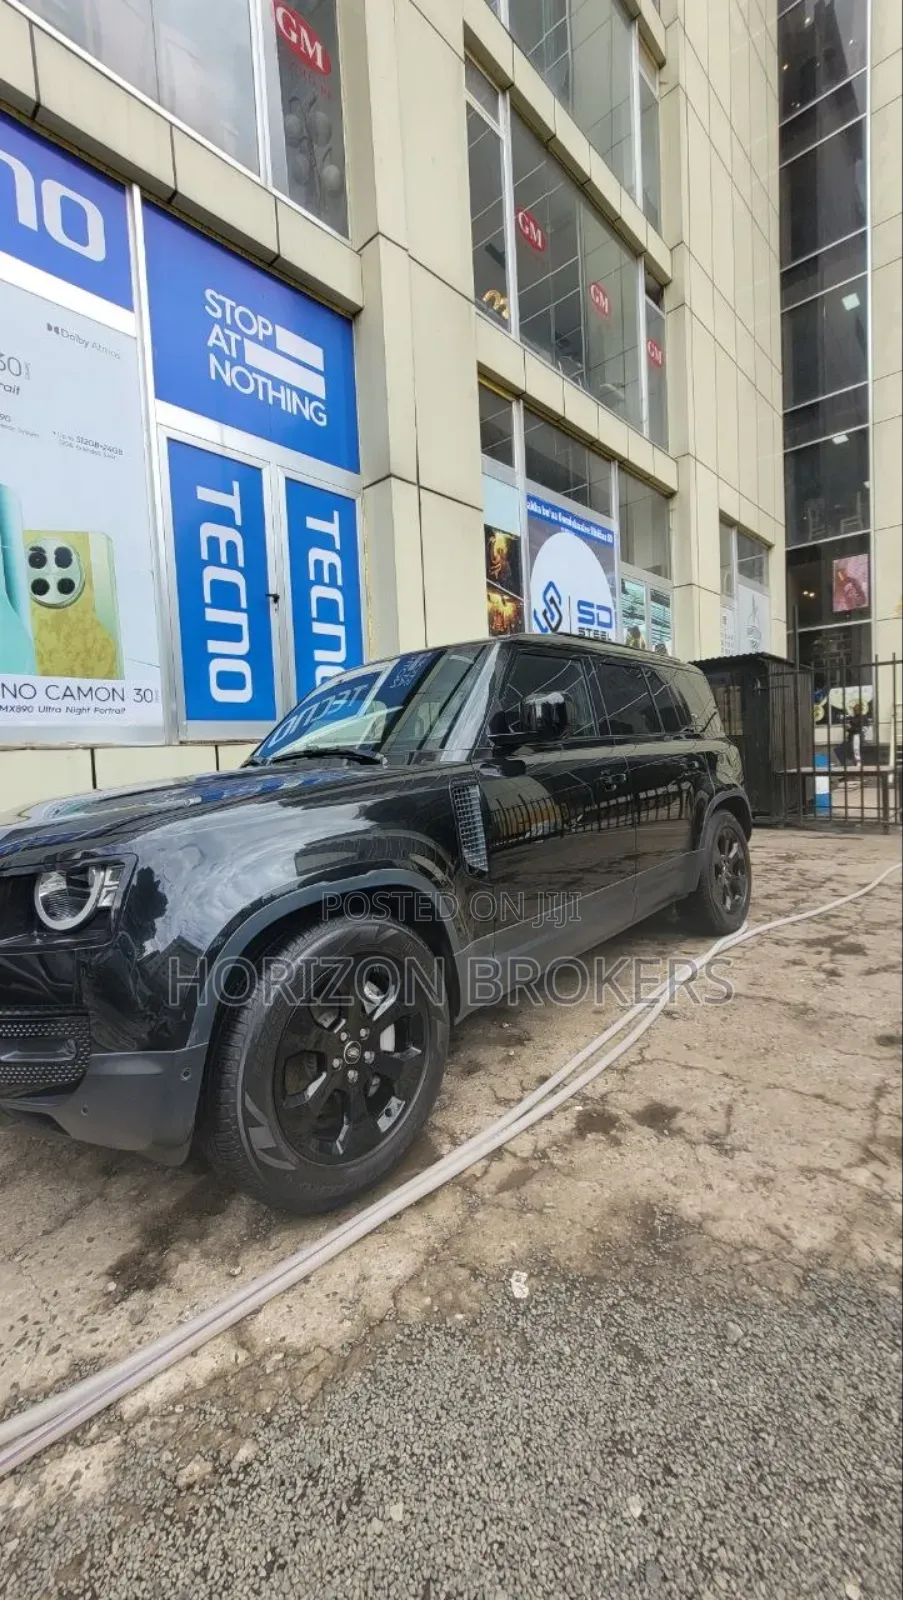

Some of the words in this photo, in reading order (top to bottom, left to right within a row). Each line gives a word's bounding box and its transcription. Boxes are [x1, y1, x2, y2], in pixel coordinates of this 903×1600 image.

[275, 6, 326, 73] GM
[518, 211, 543, 249] GM
[204, 288, 273, 342] STOP
[590, 284, 610, 316] GM
[61, 328, 89, 349] Dolby
[91, 341, 121, 360] Atmos
[207, 323, 242, 359] AT
[647, 340, 663, 365] GM
[209, 353, 327, 427] NOTHING
[196, 480, 253, 704] TECNO
[577, 599, 613, 629] SD
[578, 627, 612, 641] STEEL
[1, 682, 37, 700] NO
[45, 685, 125, 702] CAMON
[133, 688, 153, 703] 30
[0, 705, 34, 714] MX890
[38, 705, 62, 714] Ultra
[65, 705, 91, 716] Night
[94, 706, 126, 716] Portrait
